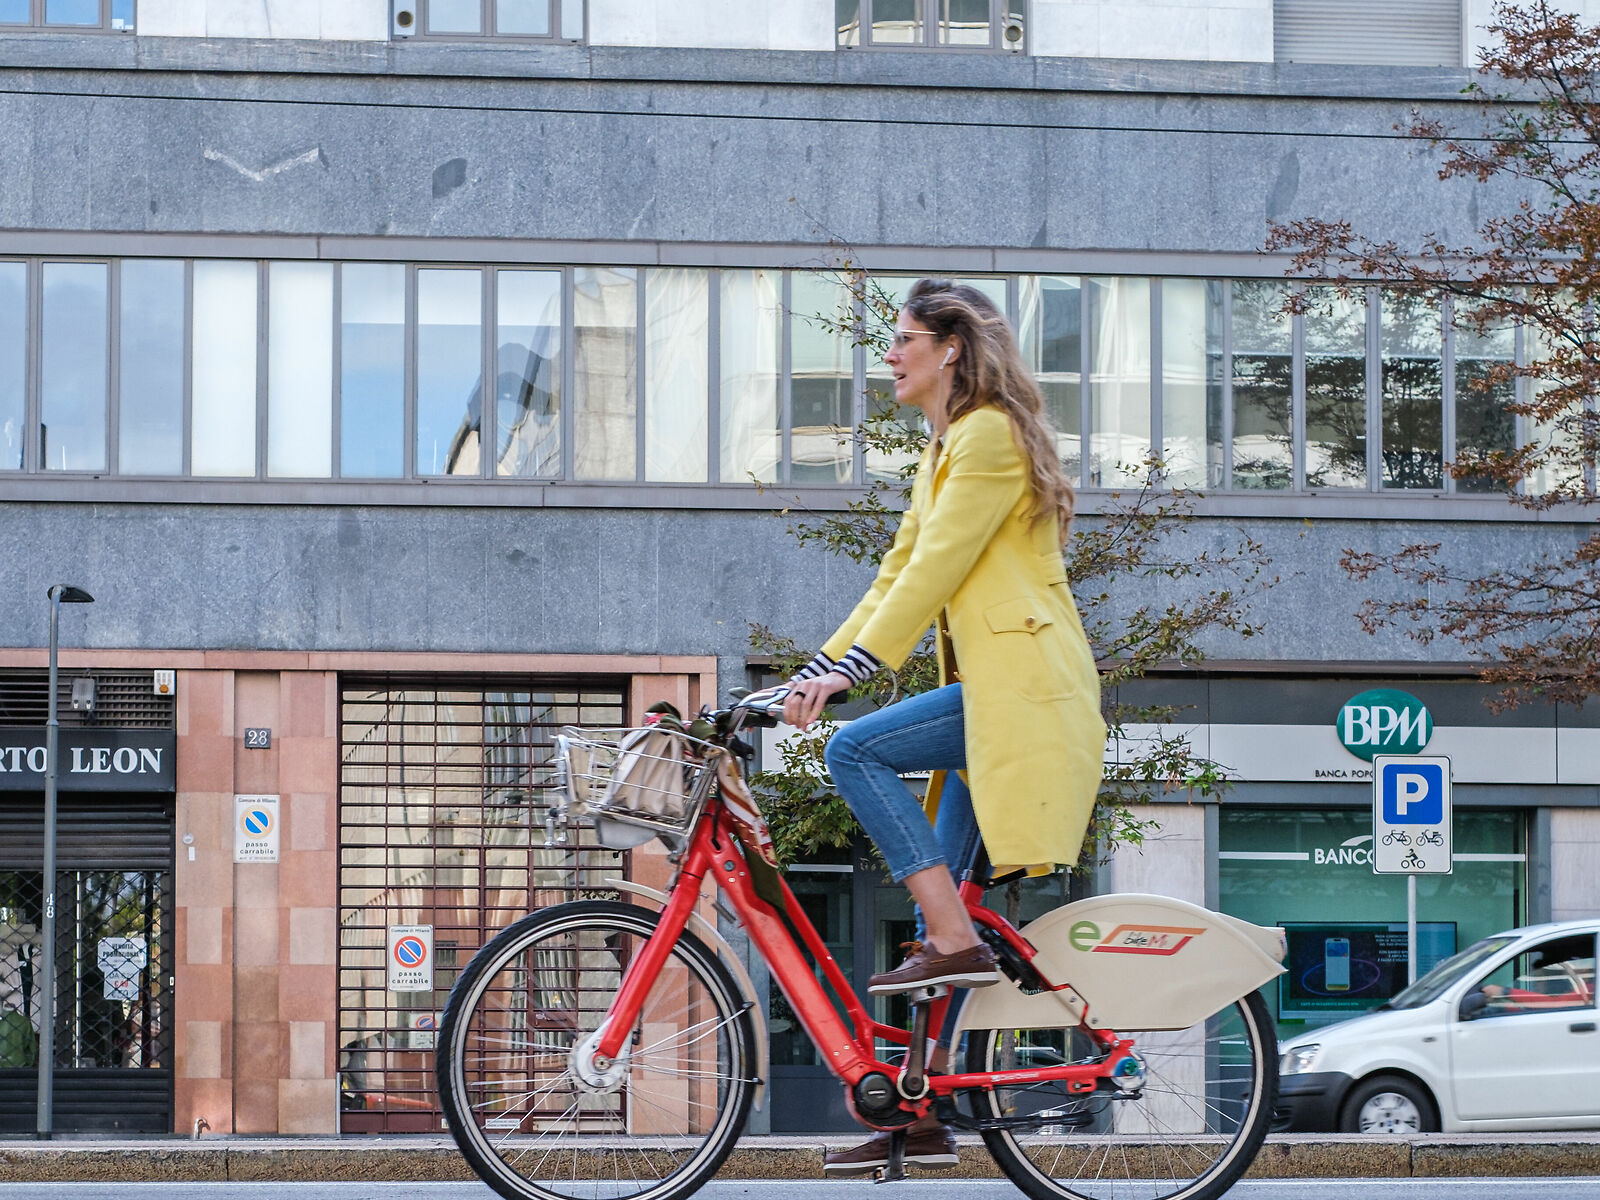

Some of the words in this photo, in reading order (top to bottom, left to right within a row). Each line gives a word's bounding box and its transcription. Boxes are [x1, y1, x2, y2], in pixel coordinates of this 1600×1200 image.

[248, 730, 267, 745] 28
[1344, 705, 1427, 747] BPM
[70, 747, 163, 773] LEON
[1315, 769, 1347, 778] BANCA
[1396, 773, 1429, 815] P
[1068, 920, 1102, 953] e
